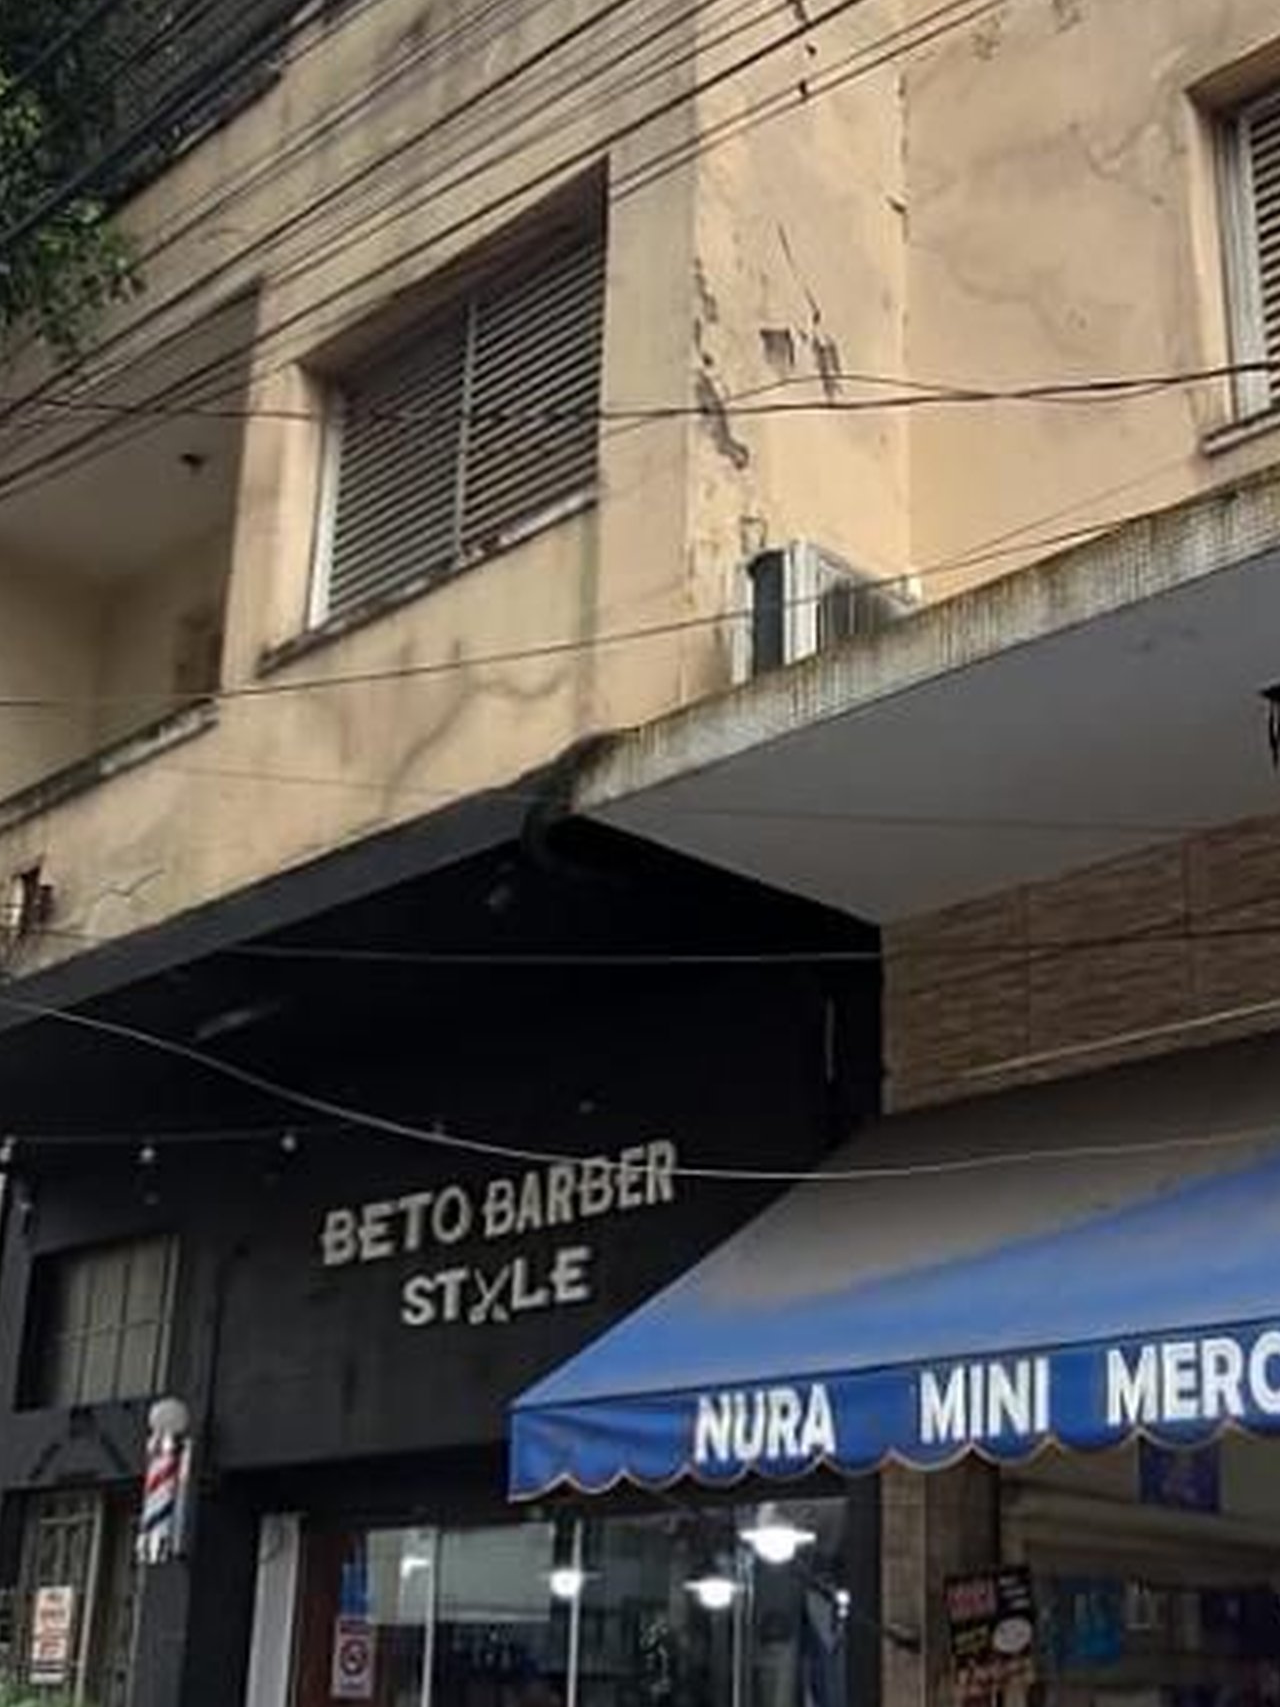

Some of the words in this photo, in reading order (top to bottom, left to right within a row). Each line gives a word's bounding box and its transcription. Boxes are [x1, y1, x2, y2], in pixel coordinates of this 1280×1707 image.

[321, 1186, 474, 1265] BETO
[483, 1140, 678, 1236] BARBER
[402, 1247, 592, 1325] STYLE
[693, 1383, 834, 1462] NURA
[920, 1357, 1050, 1444] MINI
